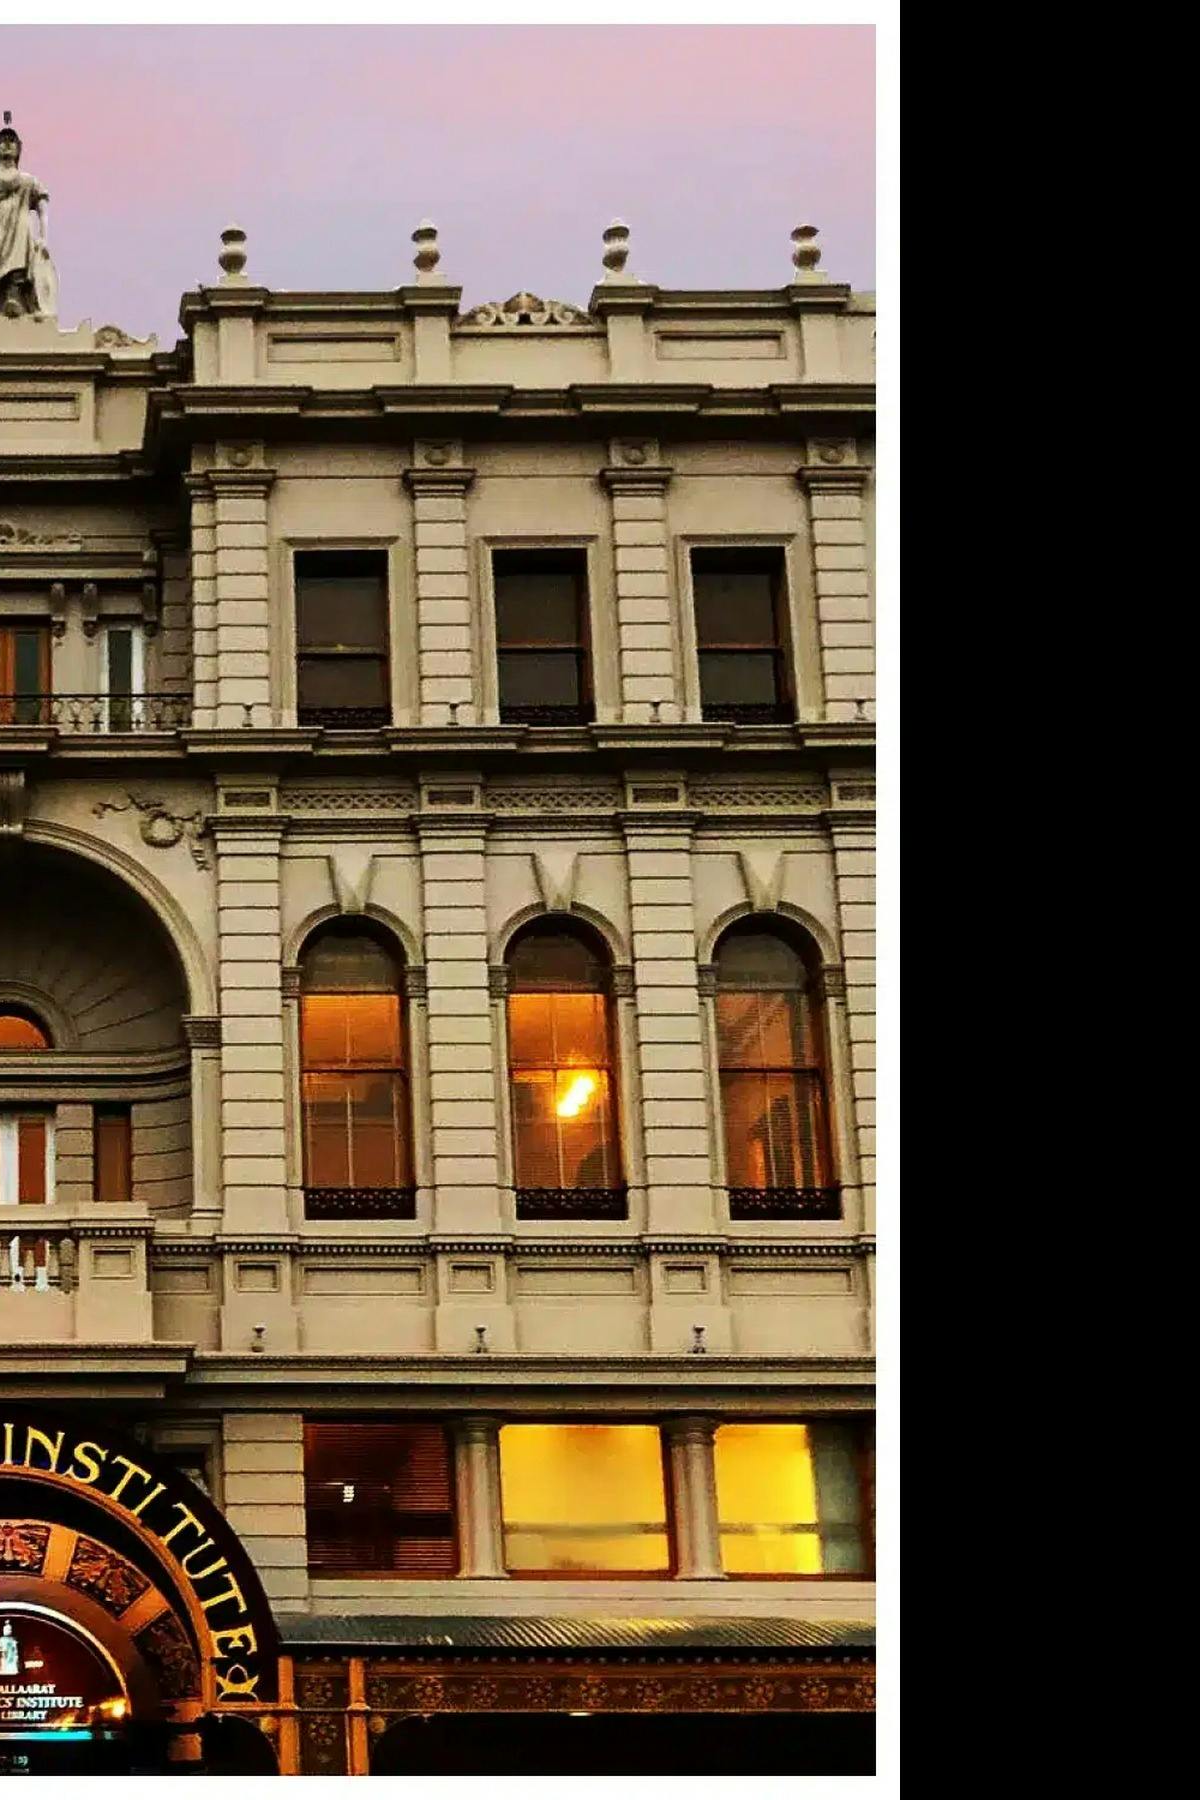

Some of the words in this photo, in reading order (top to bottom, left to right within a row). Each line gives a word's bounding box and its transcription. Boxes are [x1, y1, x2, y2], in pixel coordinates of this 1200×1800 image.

[3, 1423, 258, 1657] INSTITUTE
[16, 1697, 83, 1709] INSTITUTE
[1, 1711, 48, 1720] LIBRARY
